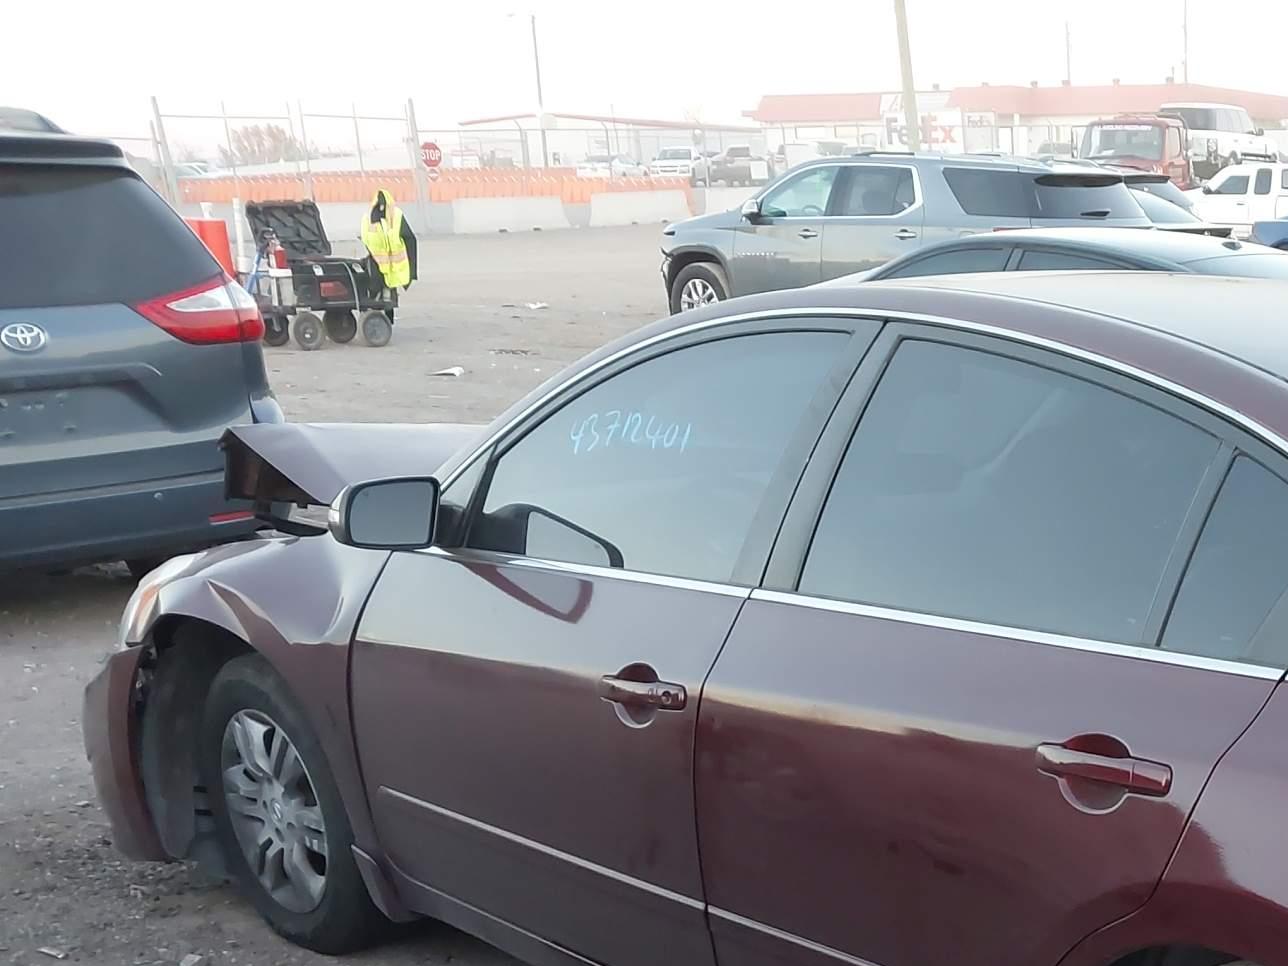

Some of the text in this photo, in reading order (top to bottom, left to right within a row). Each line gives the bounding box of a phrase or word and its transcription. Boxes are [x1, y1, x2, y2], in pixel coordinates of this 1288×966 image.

[886, 115, 957, 145] FeEx
[420, 149, 441, 161] STOP
[570, 410, 691, 455] 43712401
